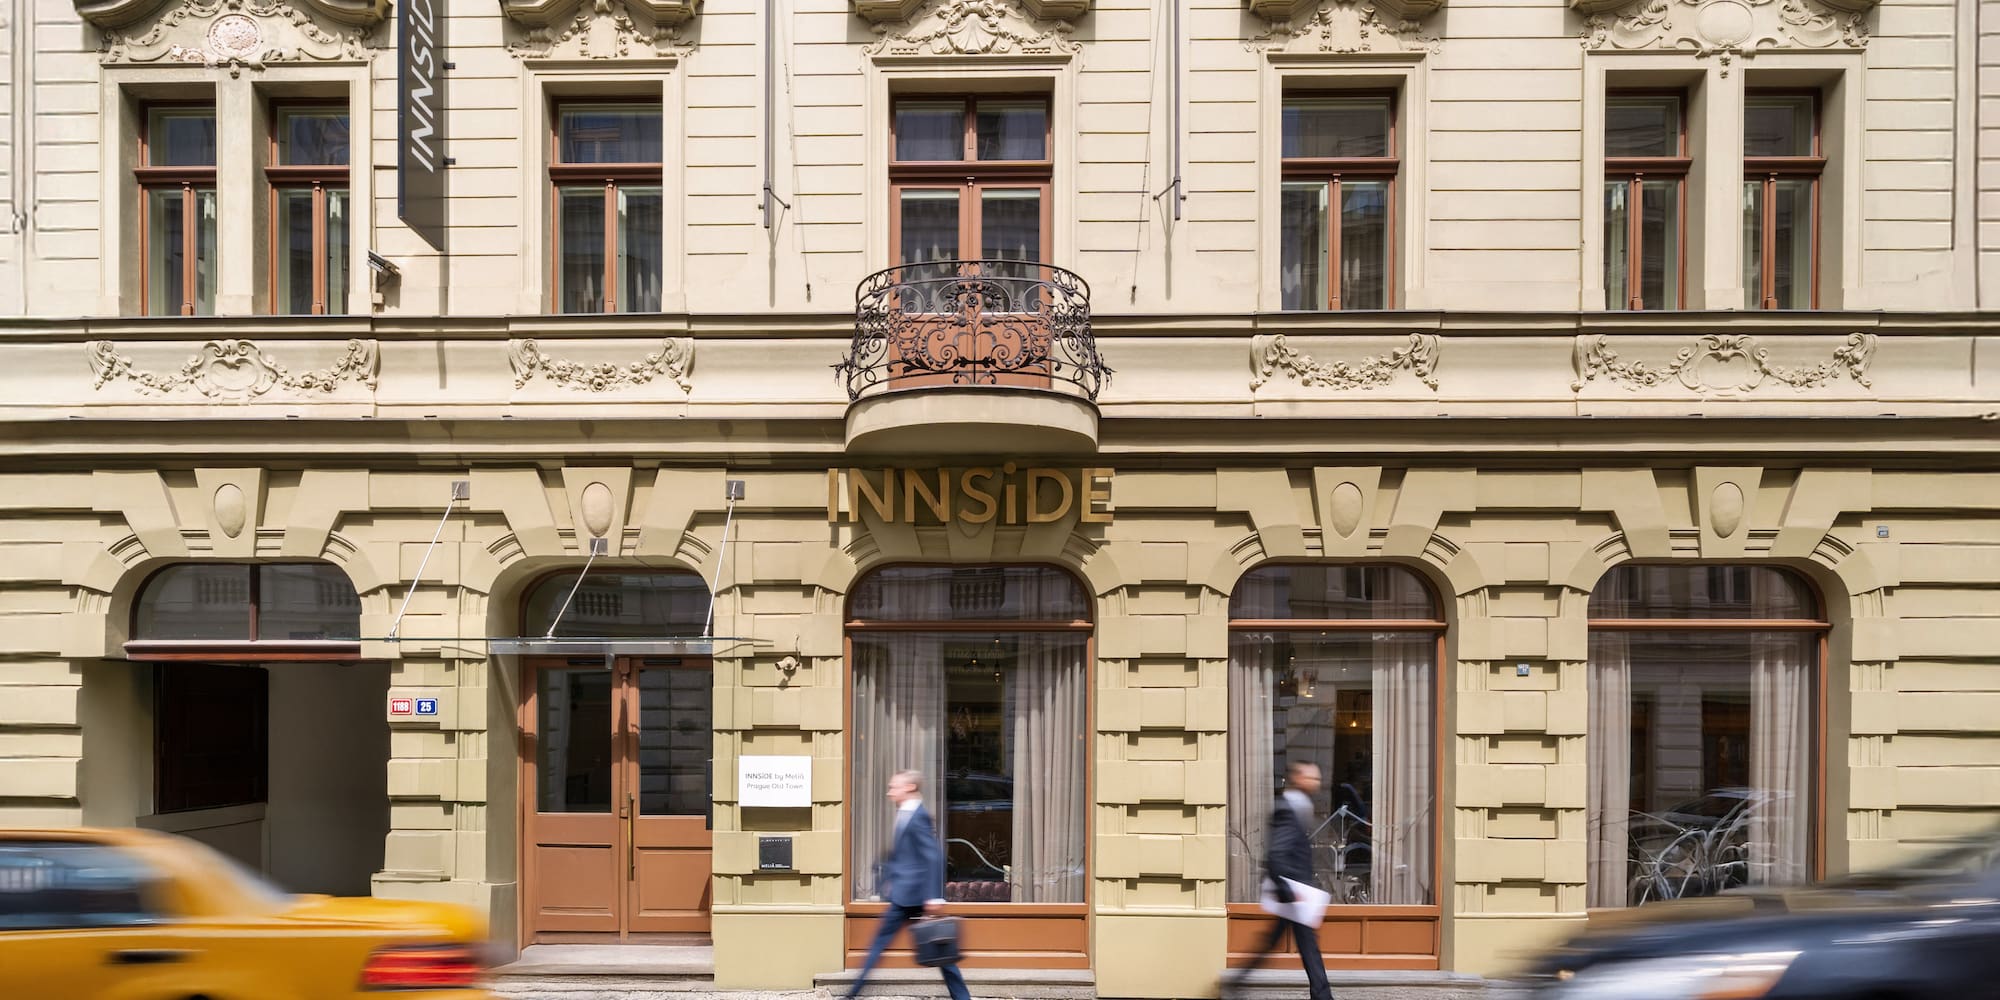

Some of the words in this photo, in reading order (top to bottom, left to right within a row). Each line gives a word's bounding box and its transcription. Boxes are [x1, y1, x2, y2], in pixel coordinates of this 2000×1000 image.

[828, 462, 1115, 524] INNSiDE
[420, 701, 432, 712] 25
[775, 773, 784, 781] by
[747, 783, 770, 791] Prague
